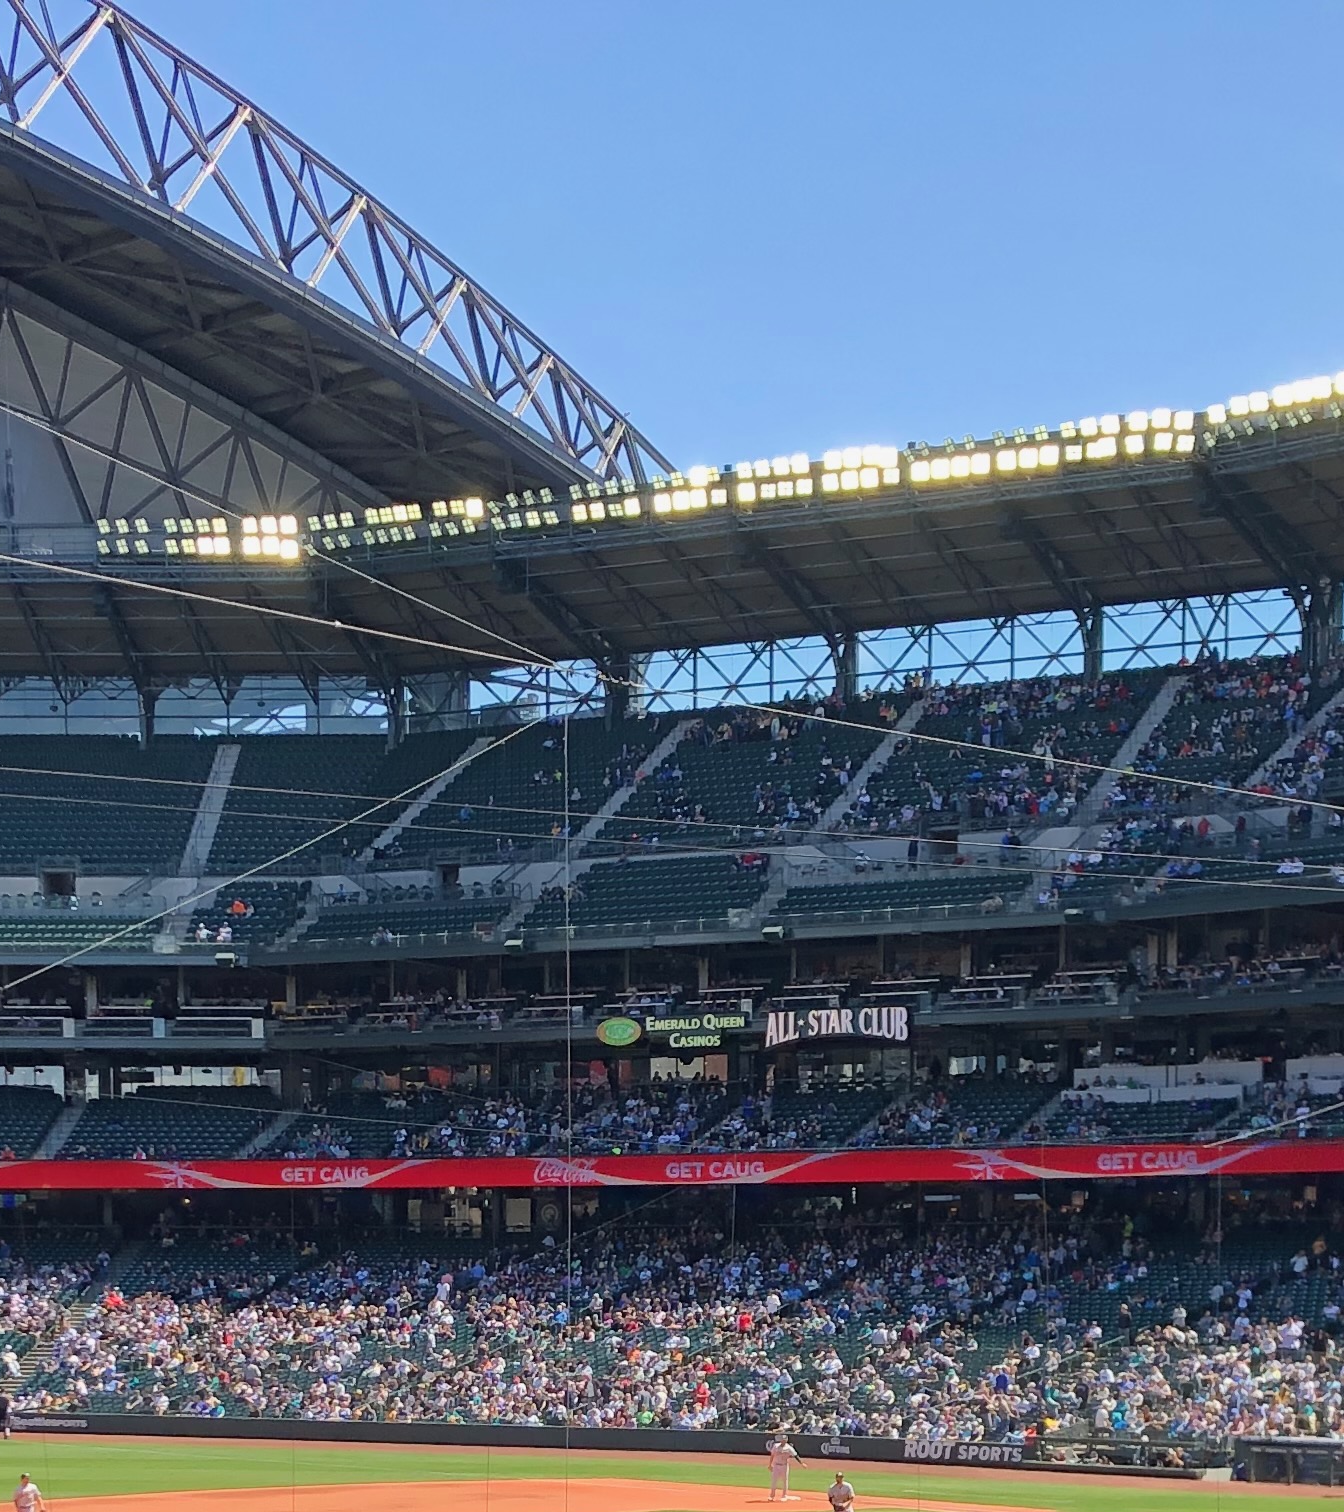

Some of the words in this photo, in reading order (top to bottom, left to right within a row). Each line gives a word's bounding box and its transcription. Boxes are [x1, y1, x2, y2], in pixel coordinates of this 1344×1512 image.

[858, 1006, 908, 1041] CLUB
[666, 1162, 704, 1179] GET
[709, 1161, 764, 1177] CAUG
[1096, 1153, 1137, 1171] GET
[1141, 1151, 1197, 1170] CAUG
[281, 1167, 316, 1183] GET
[320, 1166, 369, 1182] CAUG
[905, 1440, 955, 1460] ROOT
[957, 1444, 1022, 1463] SPORTS
